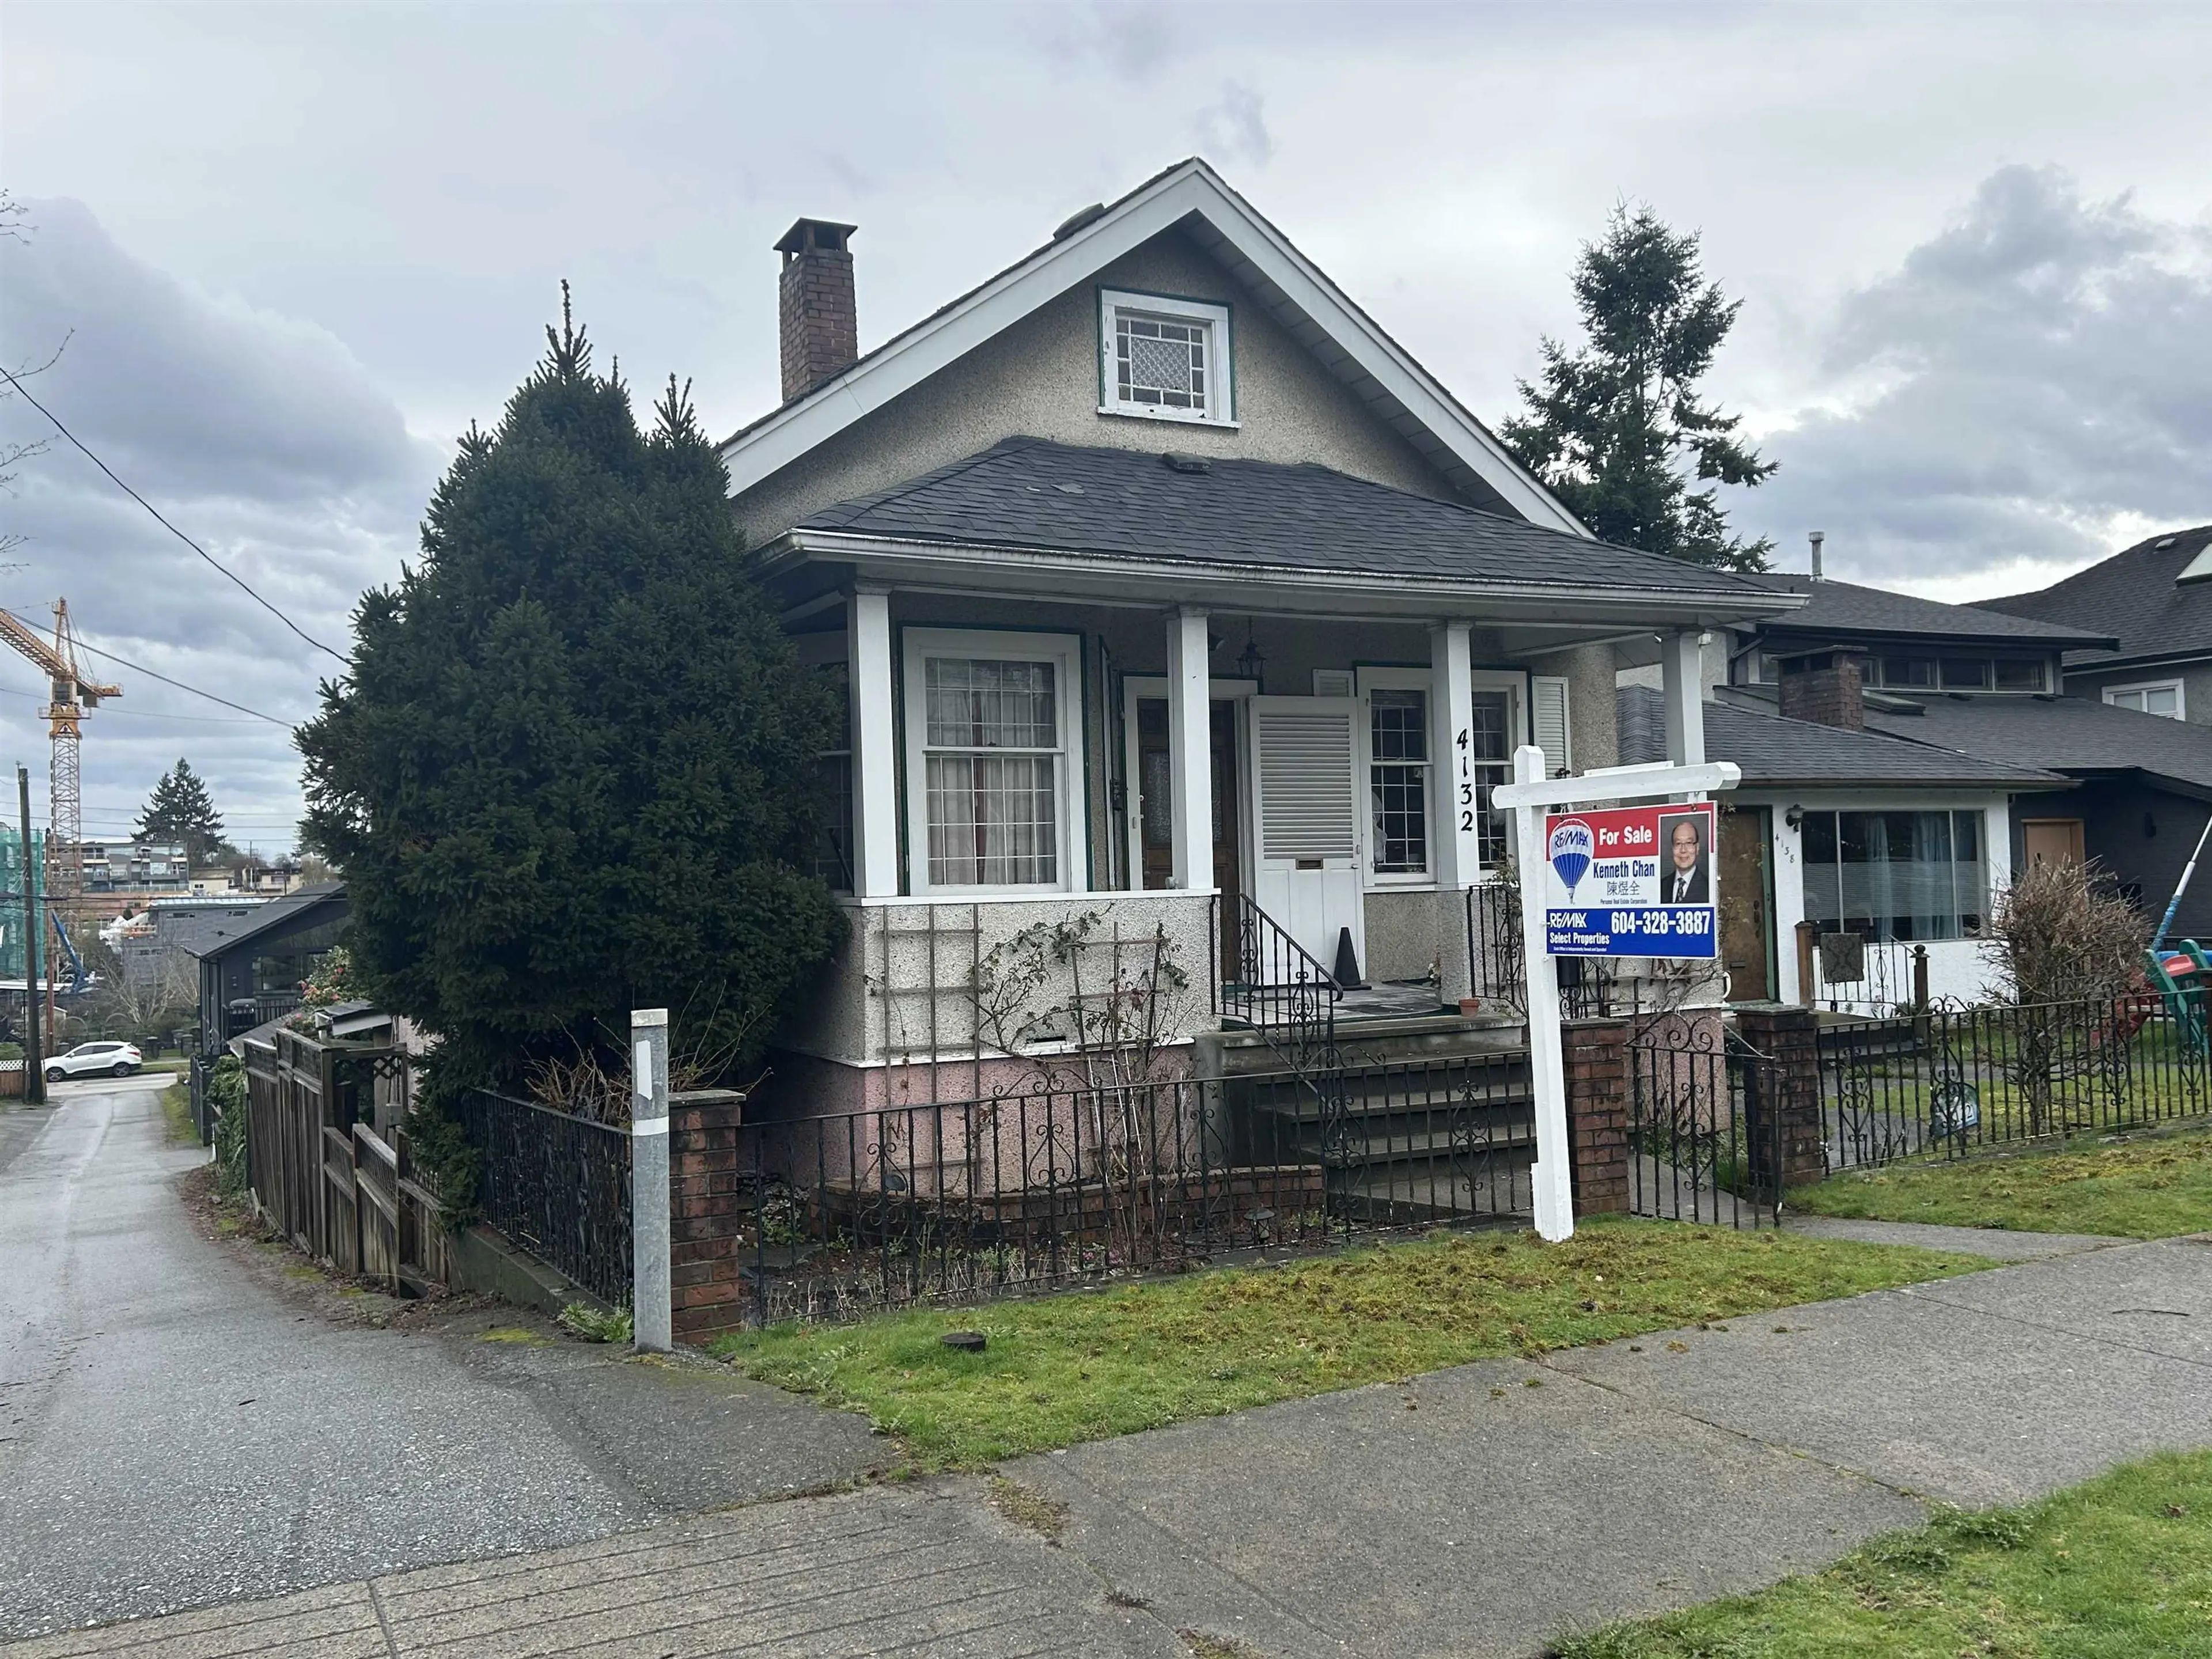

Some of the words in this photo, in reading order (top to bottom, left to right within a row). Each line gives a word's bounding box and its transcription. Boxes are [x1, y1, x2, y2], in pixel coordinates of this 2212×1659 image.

[1457, 729, 1473, 831] 4132
[1555, 830, 1589, 849] RE/MAX
[1599, 828, 1619, 846] For
[1623, 825, 1652, 844] Sale
[1593, 861, 1628, 878] Kenneth
[1633, 860, 1654, 877] Chan
[1607, 881, 1640, 896] 陳煜全
[1550, 912, 1587, 928] RE/MAX
[1611, 911, 1710, 934] 604-328-3887
[1550, 931, 1571, 944] Select
[1573, 932, 1610, 946] Properties
